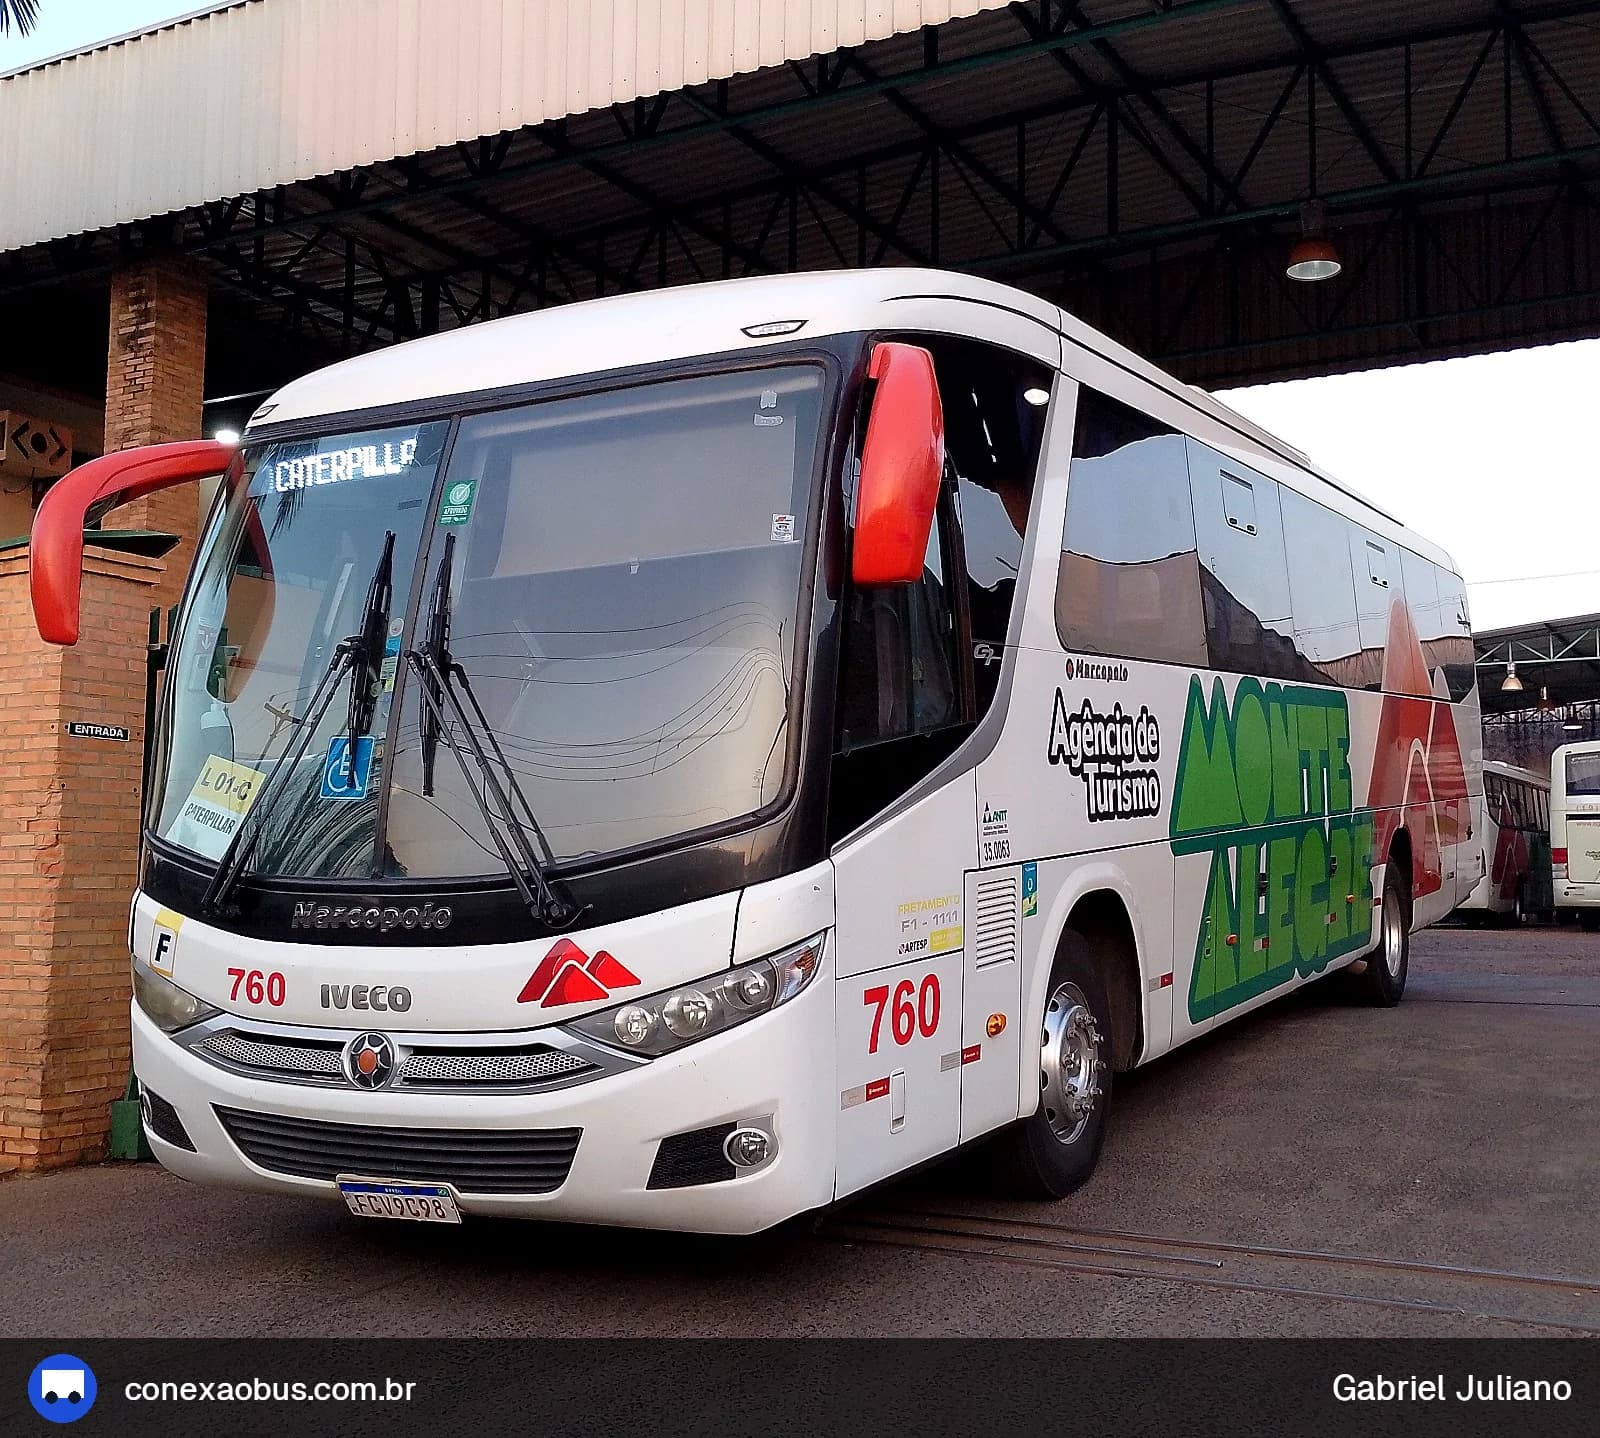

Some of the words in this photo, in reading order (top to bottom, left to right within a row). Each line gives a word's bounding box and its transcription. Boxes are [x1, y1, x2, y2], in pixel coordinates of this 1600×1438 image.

[1075, 659, 1128, 682] Marcopolo
[75, 724, 124, 738] ENTRADA
[1050, 690, 1133, 770] Agência
[1136, 708, 1159, 760] de
[1173, 684, 1350, 831] MONTE
[1083, 762, 1160, 817] Turismo
[184, 803, 237, 836] CATERPILLAR
[983, 839, 1010, 862] 35.0063
[291, 901, 453, 932] Marcopolo
[898, 895, 960, 914] FRETAMENTO
[1191, 818, 1373, 1010] ALEGRE
[901, 918, 917, 932] F1
[932, 910, 958, 926] 1111
[154, 932, 171, 962] F
[904, 939, 928, 954] ARTESP
[227, 968, 286, 1006] 760
[320, 983, 412, 1012] IVECO
[864, 973, 941, 1055] 760
[354, 1194, 446, 1218] FCV9C98
